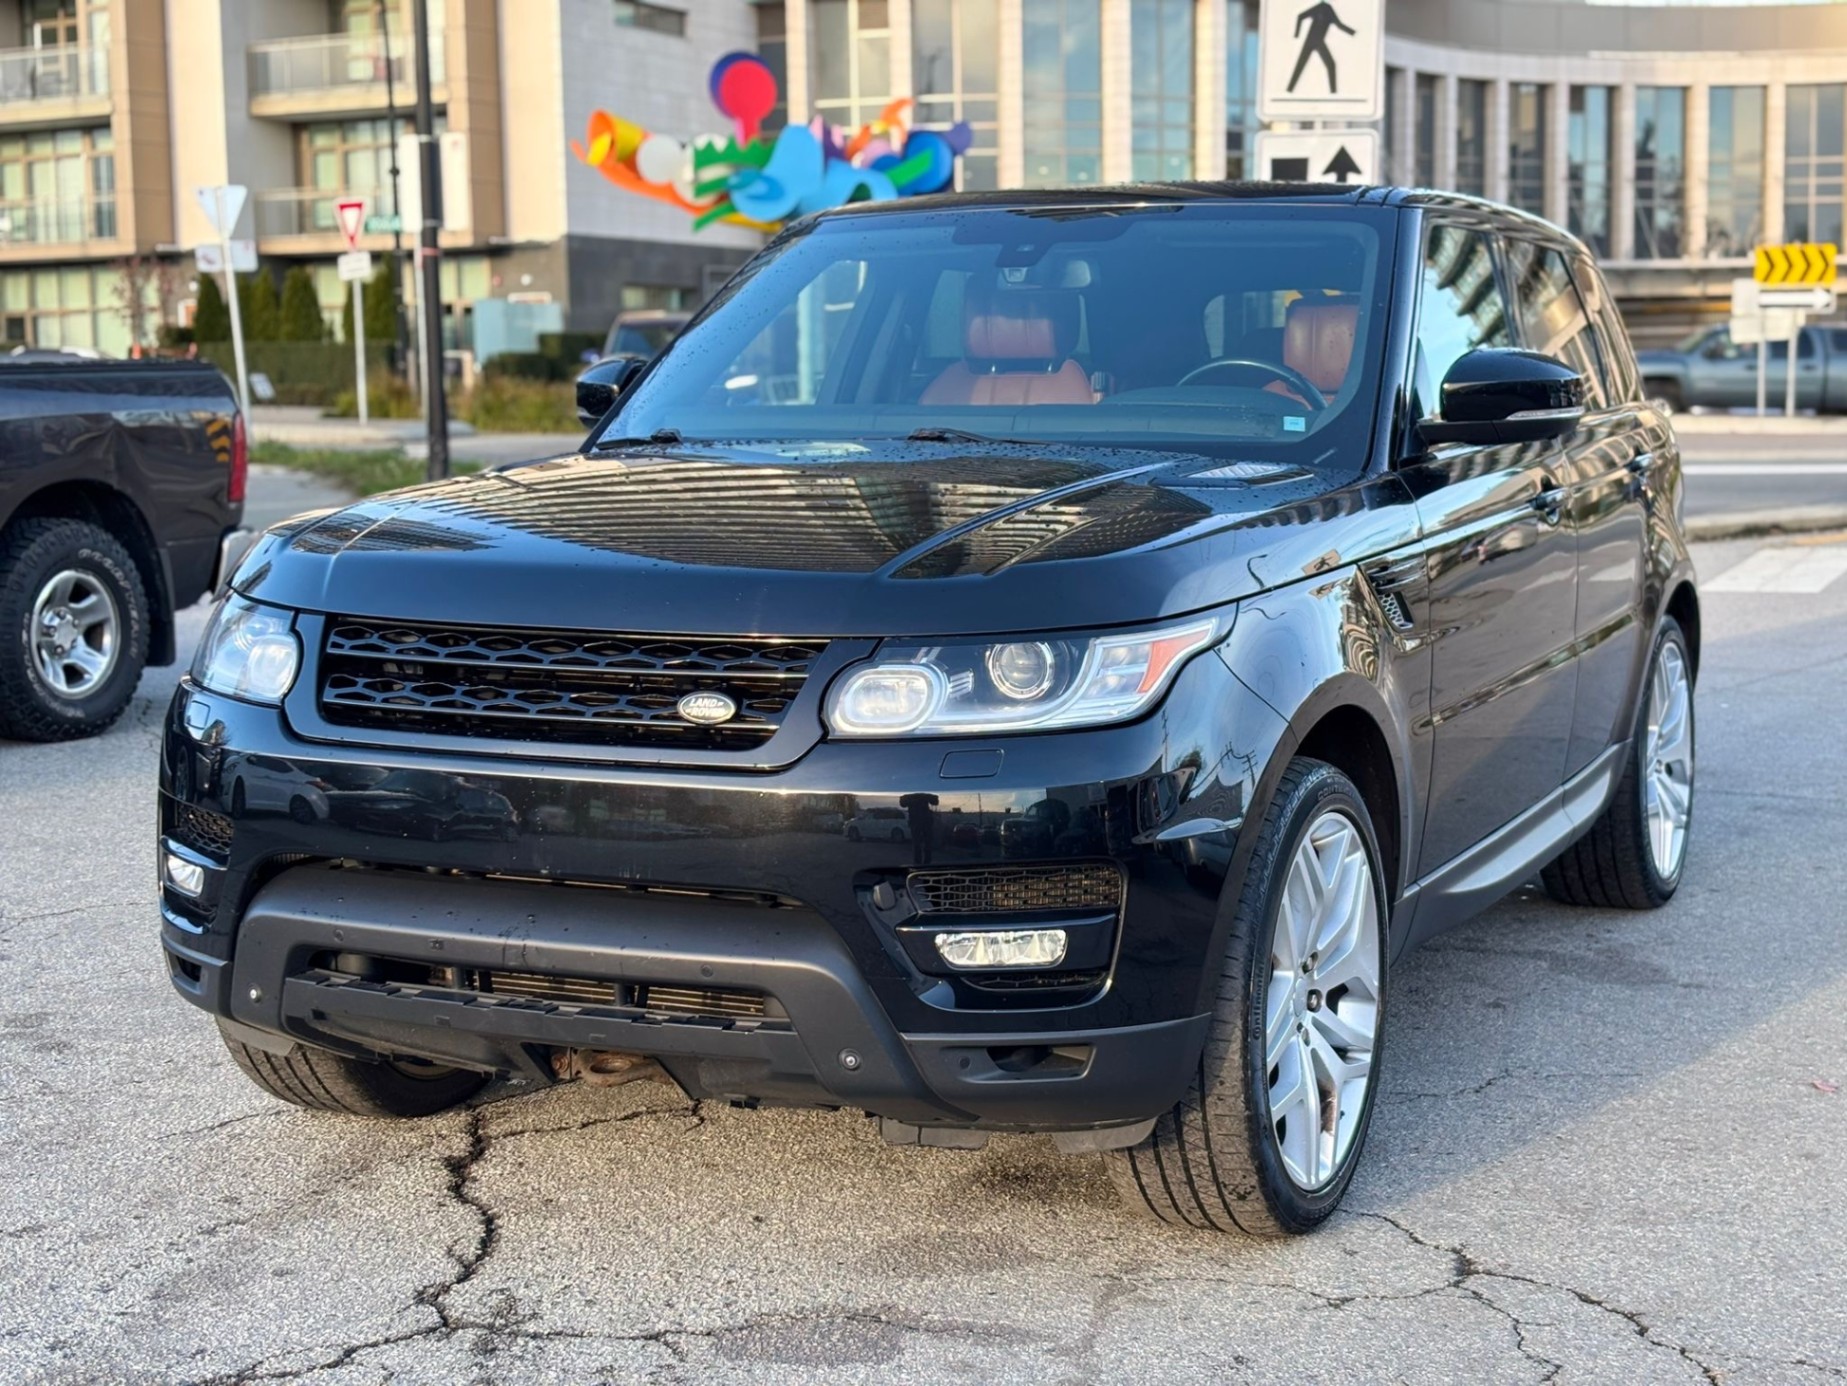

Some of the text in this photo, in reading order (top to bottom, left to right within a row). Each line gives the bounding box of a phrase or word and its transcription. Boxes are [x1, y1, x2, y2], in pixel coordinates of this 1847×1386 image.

[689, 697, 718, 707] LAND
[690, 707, 726, 718] ROV
[1252, 961, 1265, 1040] Continental
